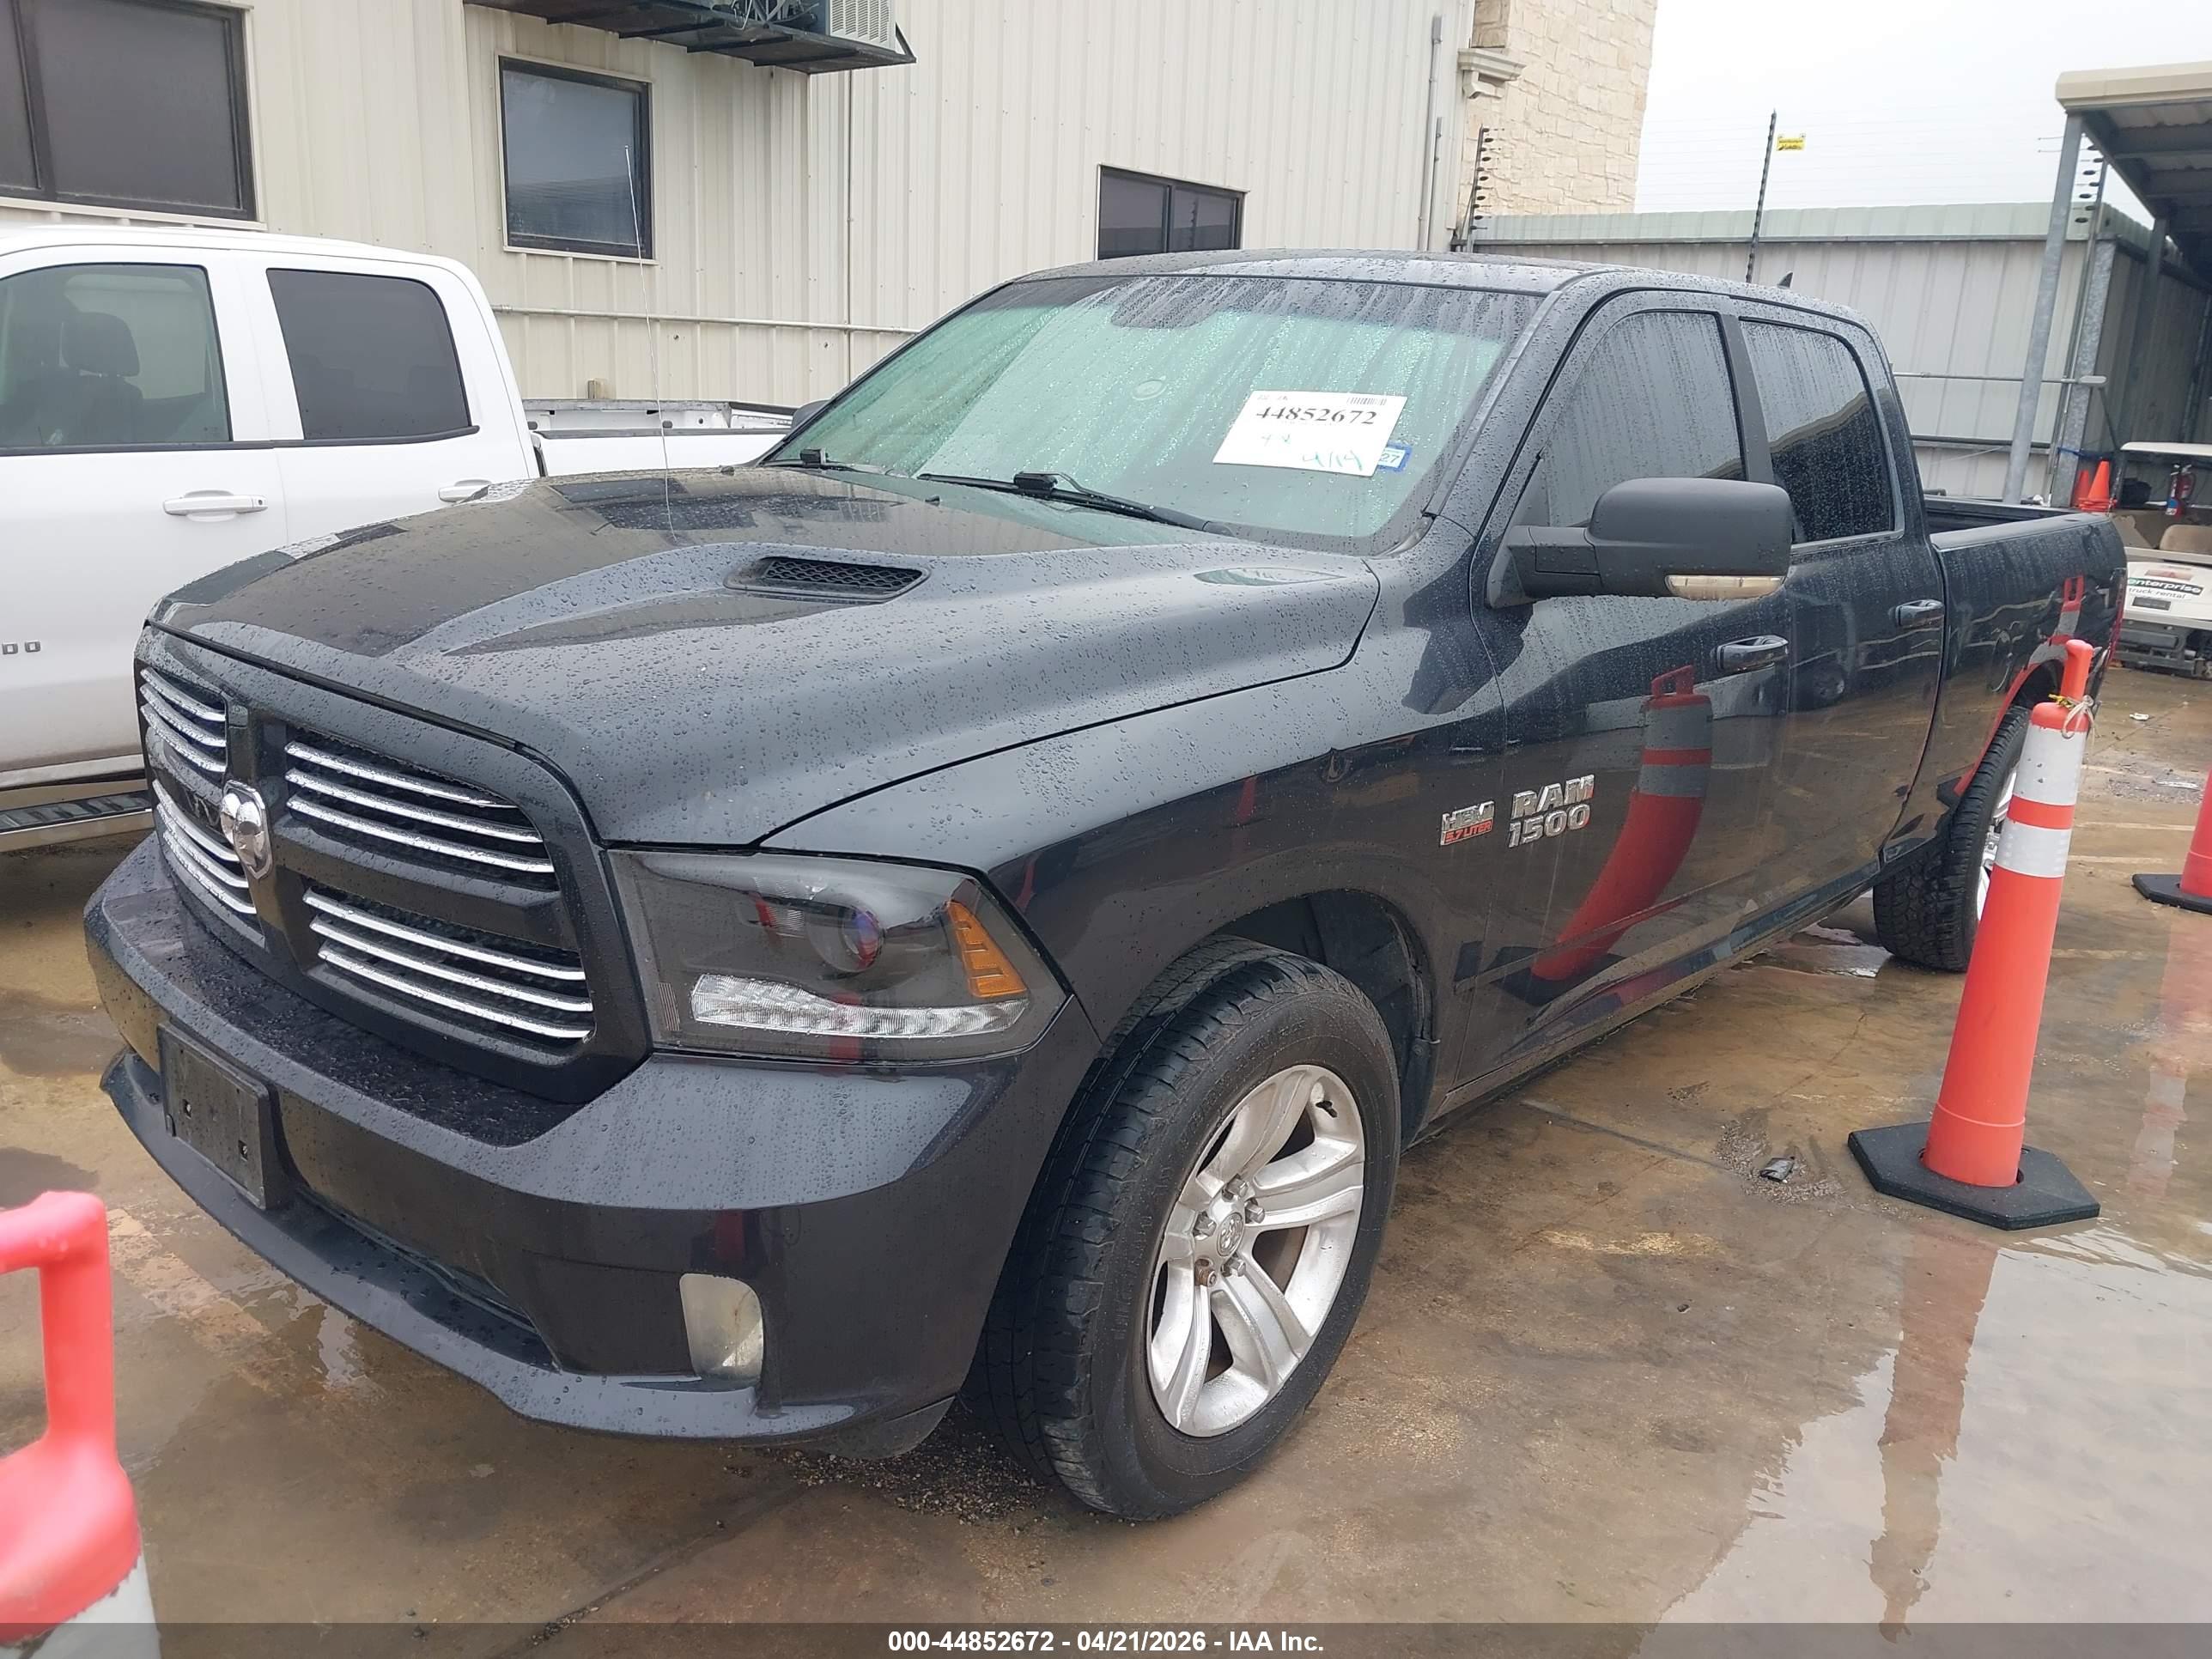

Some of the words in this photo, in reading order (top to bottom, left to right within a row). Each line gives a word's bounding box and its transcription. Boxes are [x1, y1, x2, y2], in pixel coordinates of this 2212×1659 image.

[1256, 406, 1377, 424] 44852672
[2128, 578, 2202, 593] enterprise
[2155, 590, 2186, 599] rental
[1510, 774, 1595, 819] RAM
[1445, 830, 1463, 842] 5.7
[1463, 821, 1492, 836] LITER
[1508, 803, 1591, 848] 1500
